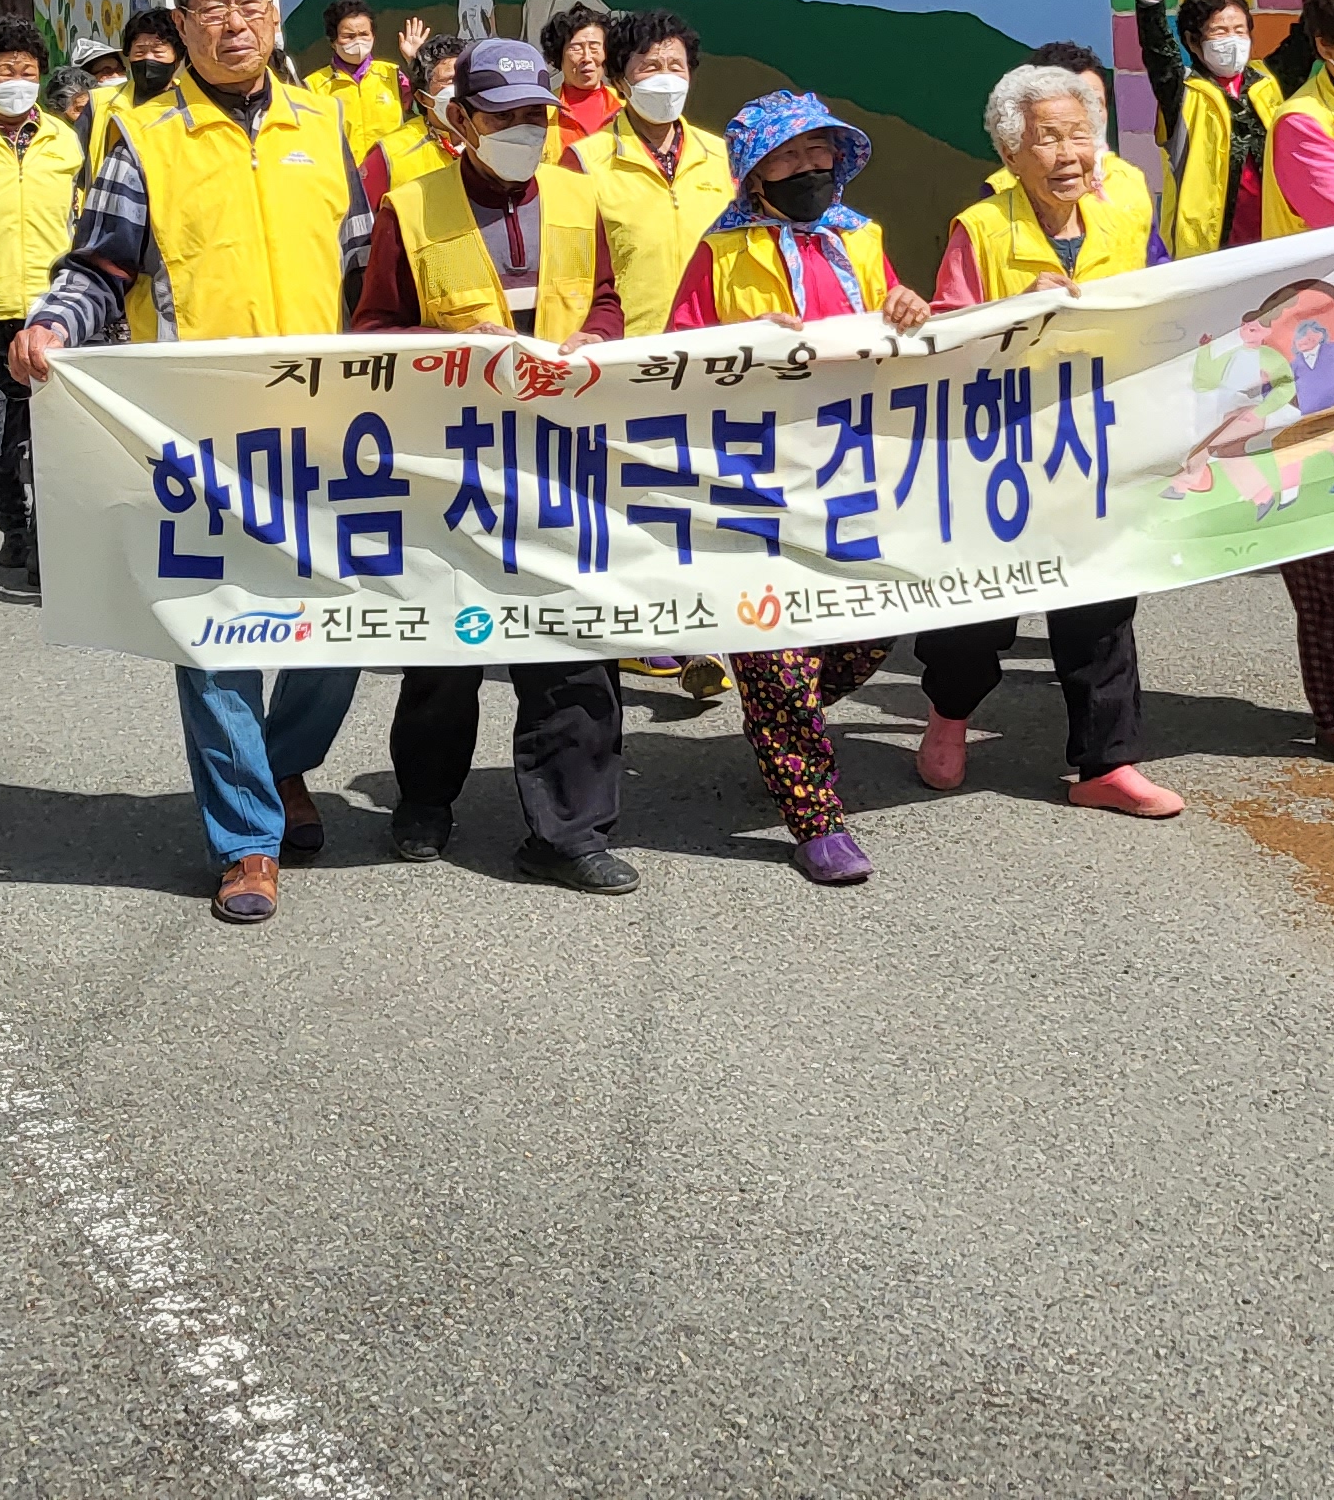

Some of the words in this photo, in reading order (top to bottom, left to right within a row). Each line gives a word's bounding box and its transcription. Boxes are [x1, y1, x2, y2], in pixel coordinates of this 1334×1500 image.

[146, 410, 410, 580] 한마음
[443, 405, 787, 575] 치매극복
[815, 355, 1117, 563] 걷기행사
[783, 554, 1069, 626] 진도군치매안심센터
[190, 615, 292, 647] Jindo
[320, 605, 430, 643] 진도군
[498, 594, 719, 640] 진도군보건소
